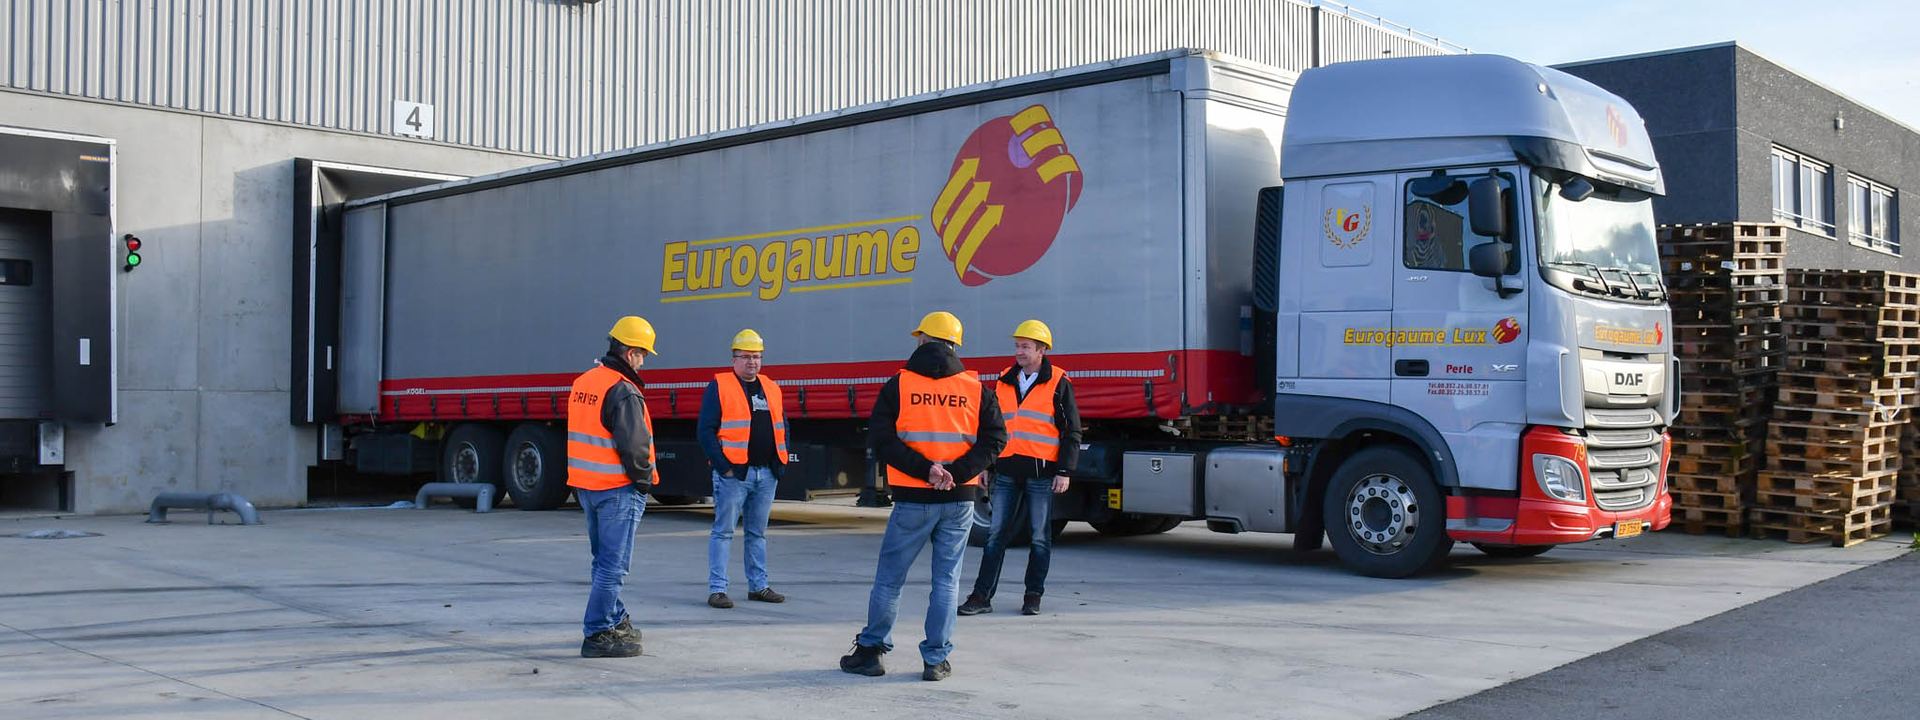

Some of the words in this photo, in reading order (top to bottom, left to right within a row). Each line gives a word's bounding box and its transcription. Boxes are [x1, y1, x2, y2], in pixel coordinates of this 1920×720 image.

[405, 106, 422, 132] 4
[660, 225, 921, 301] Eurogaume
[1343, 327, 1446, 348] Eurogaume
[1452, 327, 1488, 344] Lux
[1446, 364, 1473, 374] Perle
[1492, 364, 1519, 372] XF
[1615, 372, 1643, 386] DAF
[573, 391, 599, 406] DRIVER
[911, 393, 968, 408] DRIVER
[1574, 444, 1585, 461] 79
